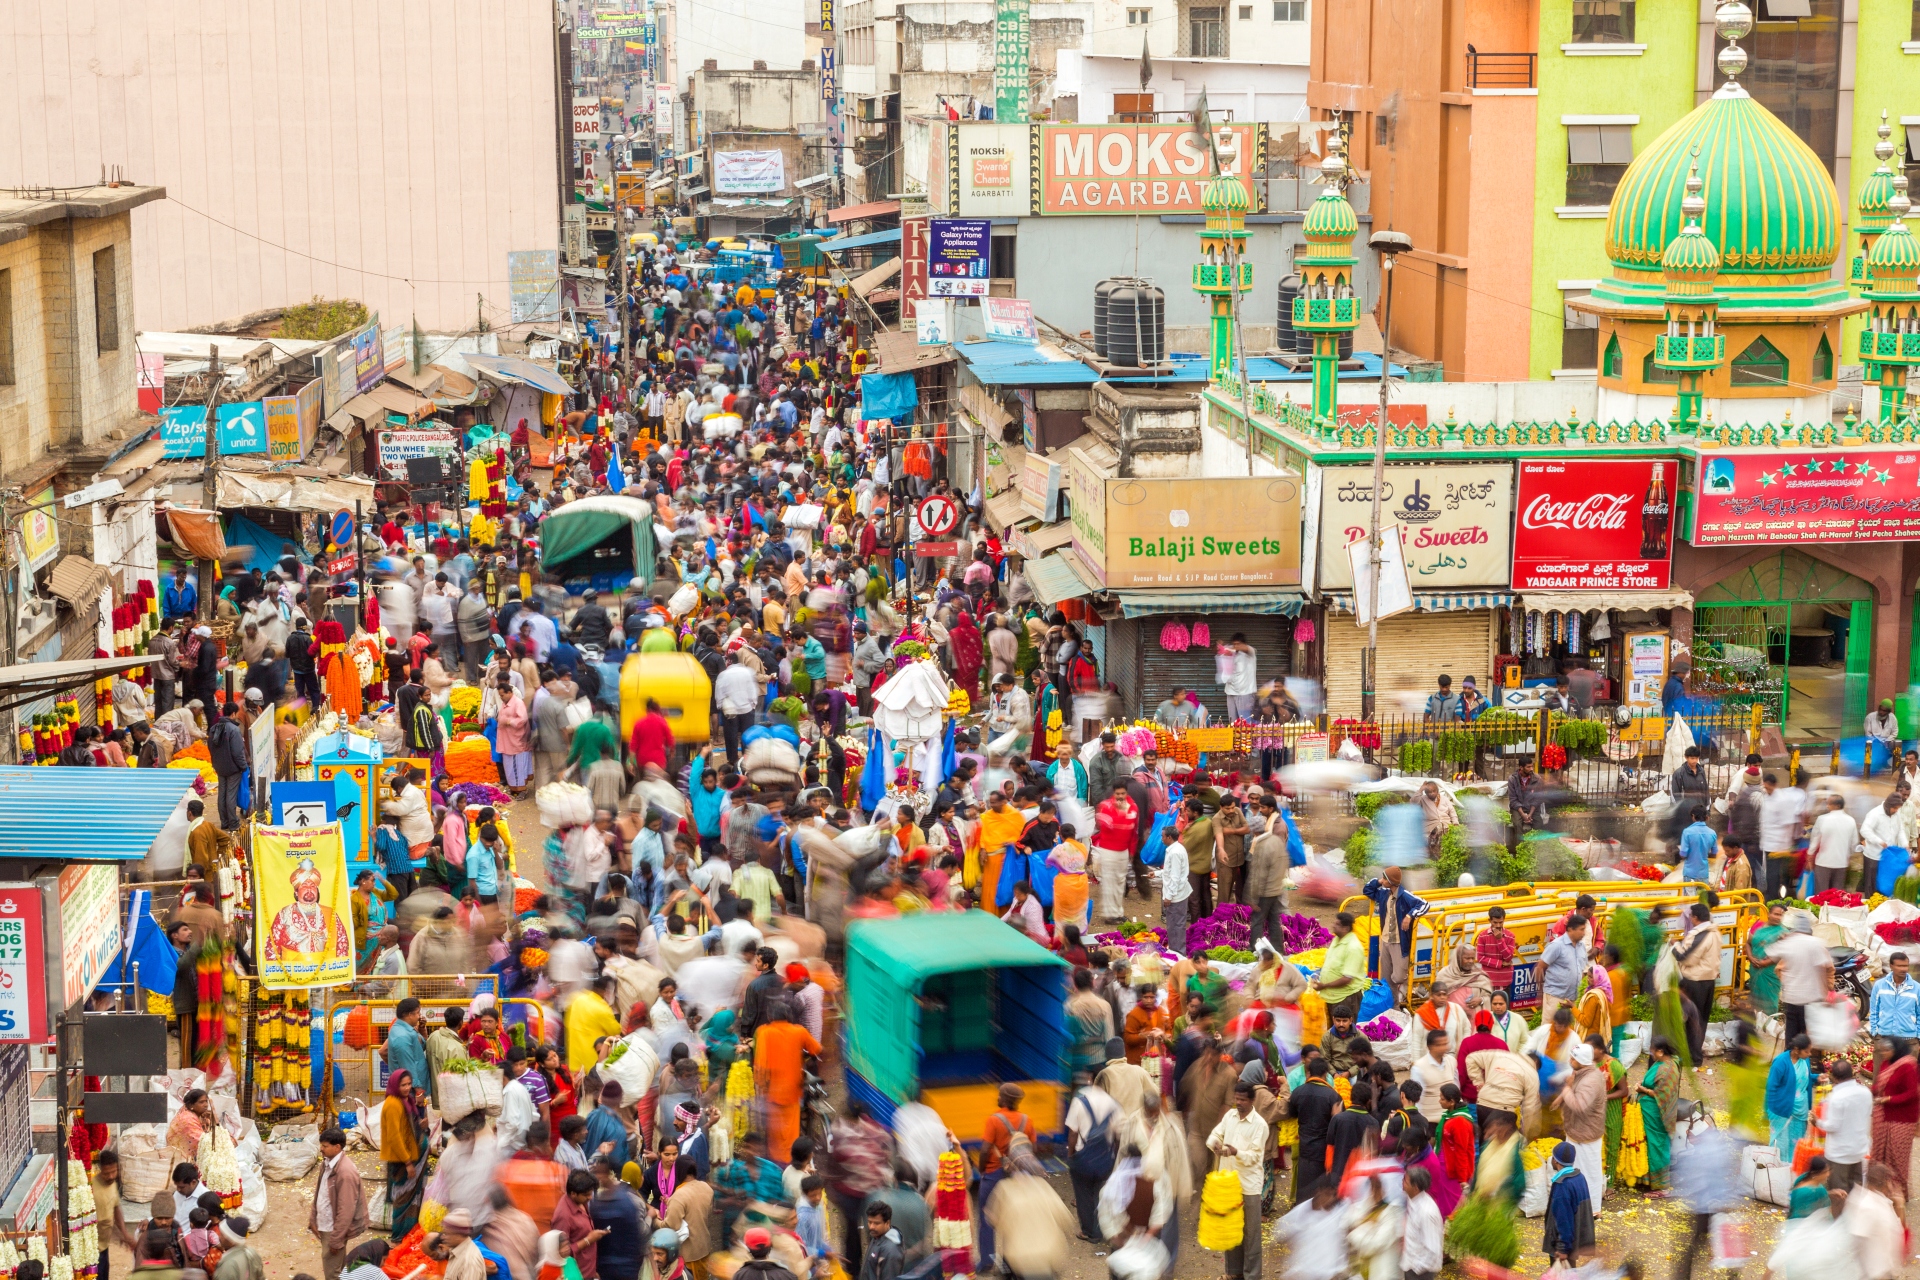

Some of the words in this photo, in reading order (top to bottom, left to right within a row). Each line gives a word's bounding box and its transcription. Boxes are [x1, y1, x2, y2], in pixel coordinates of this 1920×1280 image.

[822, 0, 833, 31] DRA
[997, 2, 1028, 12] NEW
[578, 28, 607, 38] Society
[997, 21, 1008, 98] CHANDRA
[1008, 21, 1018, 87] BHAVAN
[822, 48, 834, 99] VIHAR
[1018, 13, 1029, 122] RESTAURANT
[574, 103, 599, 117] ಬಾರ್
[574, 122, 599, 133] BAR
[584, 152, 594, 196] BAR
[976, 160, 1008, 171] Swarna
[974, 173, 1010, 185] Champa
[586, 217, 608, 226] BAR
[905, 220, 925, 315] TITAN
[231, 438, 257, 448] uninor
[1523, 493, 1635, 529] Coca-Cola
[1642, 502, 1668, 514] Coca-Cola
[1071, 496, 1085, 540] Balaji
[1086, 517, 1104, 554] Sweets
[1414, 525, 1488, 548] Sweets
[1129, 536, 1195, 563] Balaji
[1202, 536, 1280, 555] Sweets
[1158, 573, 1172, 582] Road
[1240, 572, 1273, 581] Bangalore.2
[1526, 577, 1577, 587] YADGAAR
[1580, 577, 1619, 586] PRINCE
[1622, 577, 1658, 586] STORE
[97, 924, 118, 968] wires
[1514, 984, 1540, 994] CEMEN
